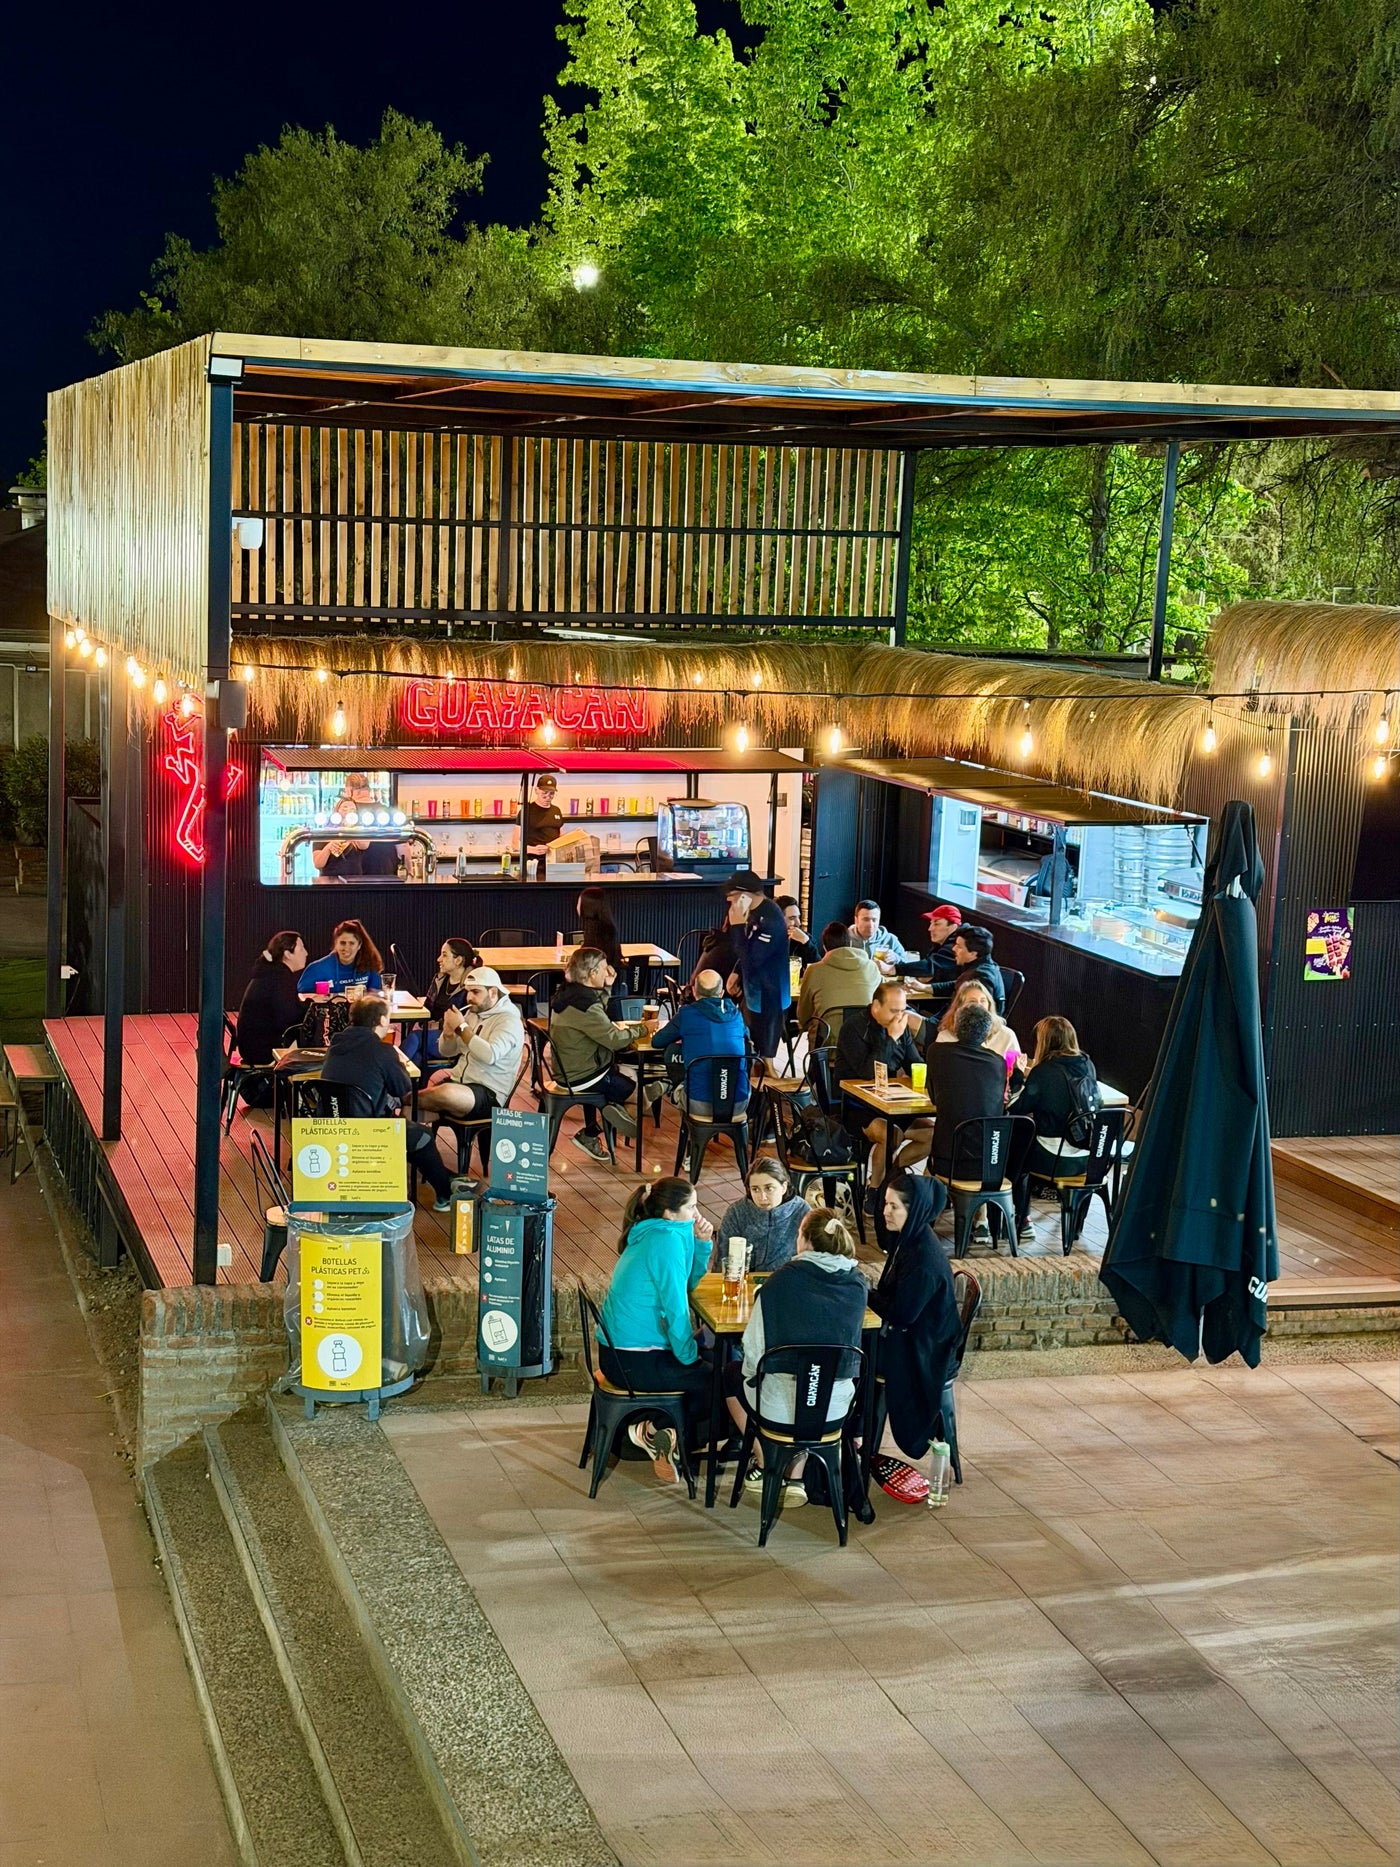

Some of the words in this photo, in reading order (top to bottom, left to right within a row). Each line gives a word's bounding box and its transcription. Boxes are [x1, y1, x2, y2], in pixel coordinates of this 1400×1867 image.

[720, 1068, 728, 1100] GUAYACÁN
[497, 1108, 514, 1117] LATAS
[312, 1118, 347, 1126] BOTELLAS
[496, 1118, 523, 1128] ALUMINIO
[301, 1127, 338, 1135] PLÁSTICAS
[990, 1130, 1001, 1165] GUAYACÁN
[486, 1235, 504, 1245] LATAS
[505, 1237, 515, 1245] DE
[486, 1244, 515, 1255] ALUMINIO
[322, 1257, 357, 1266] BOTELLAS
[311, 1265, 347, 1275] PLÁSTICAS
[348, 1267, 362, 1275] PET
[806, 1363, 821, 1407] GUAYACÁN
